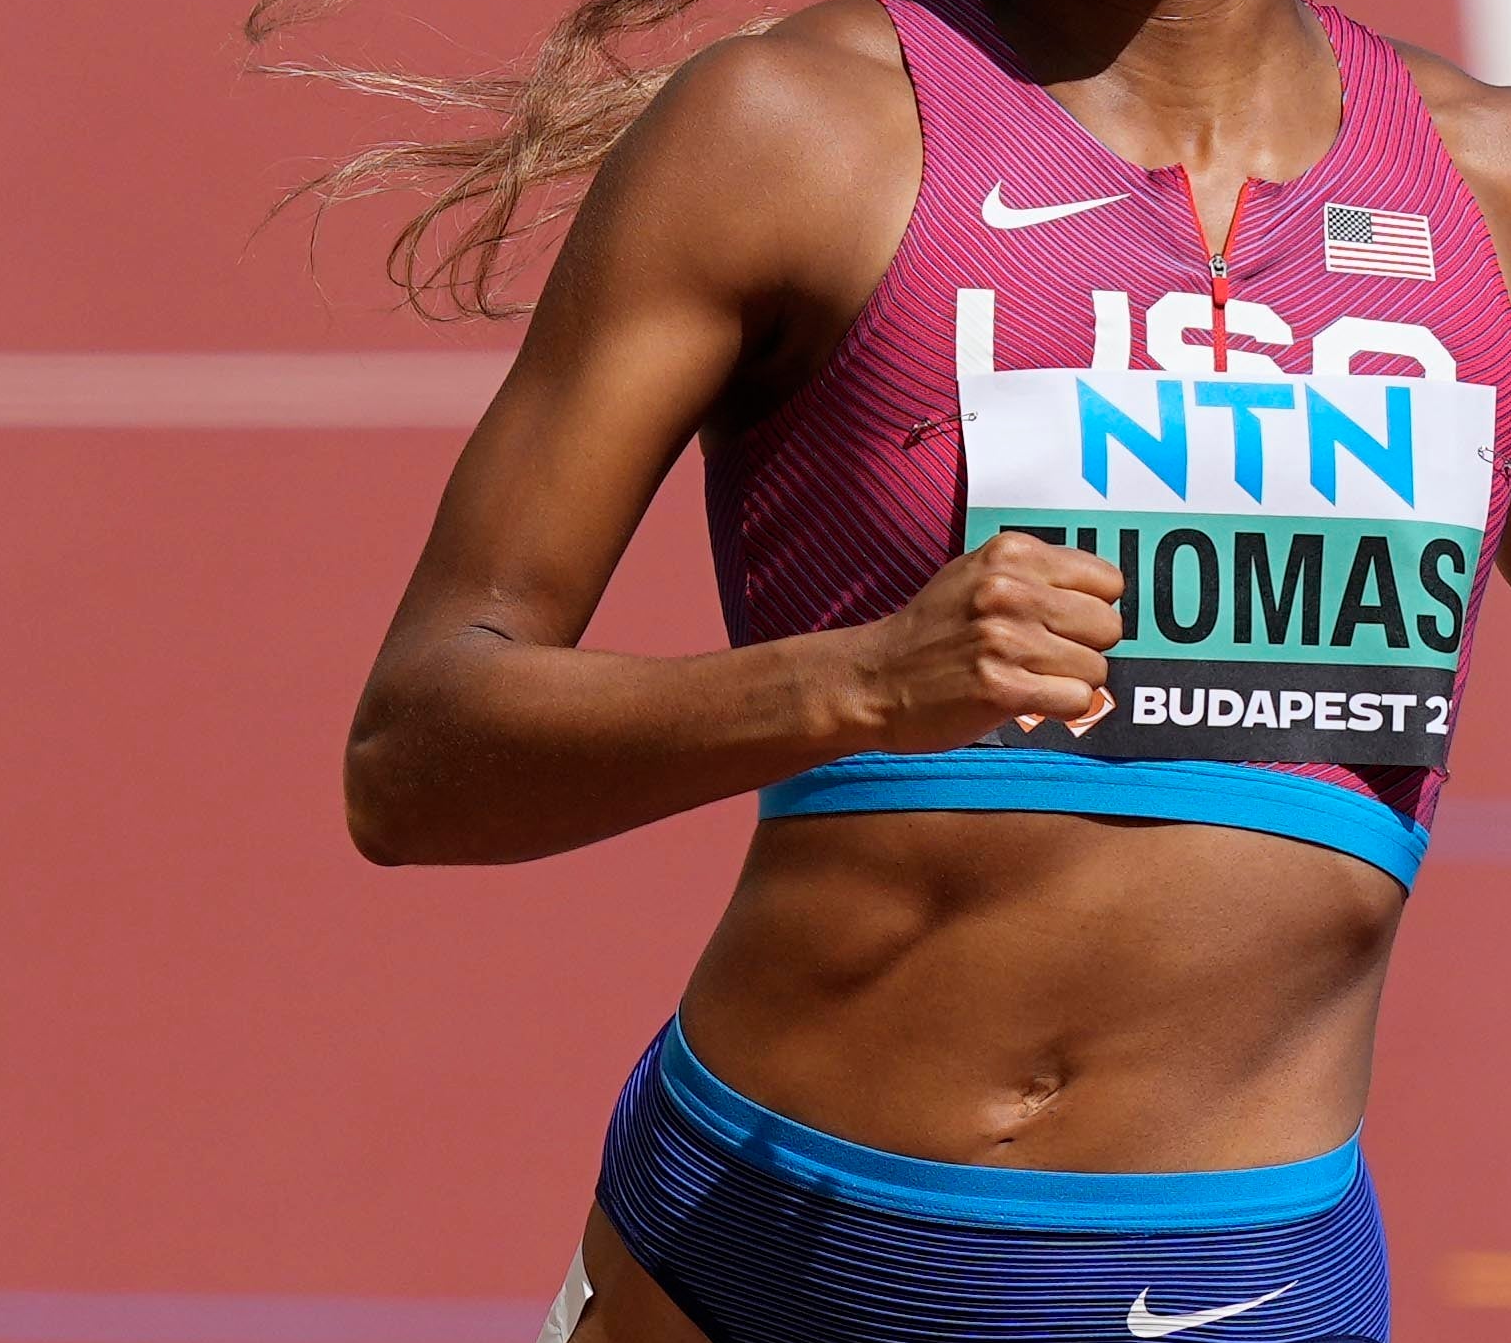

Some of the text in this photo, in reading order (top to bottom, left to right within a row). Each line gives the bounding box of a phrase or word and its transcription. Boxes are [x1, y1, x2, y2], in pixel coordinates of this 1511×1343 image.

[1076, 376, 1416, 510] NTN
[999, 524, 1467, 654] HOMAS
[1132, 685, 1418, 733] BUDAPEST
